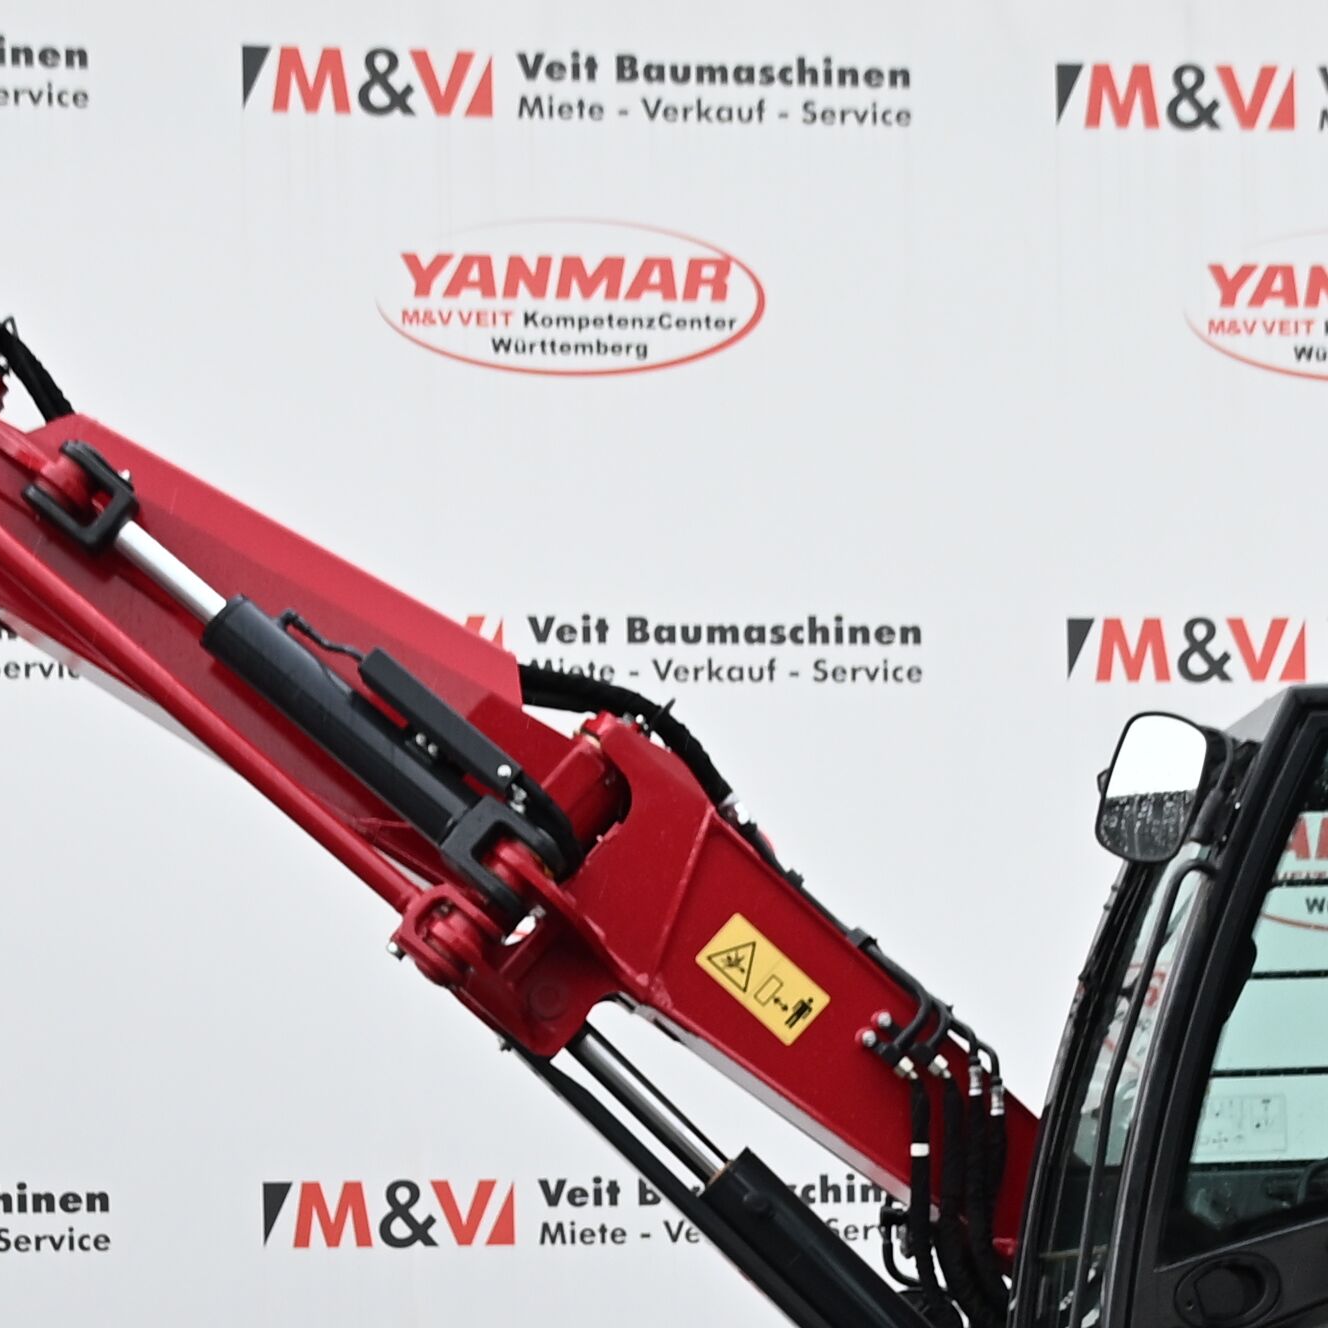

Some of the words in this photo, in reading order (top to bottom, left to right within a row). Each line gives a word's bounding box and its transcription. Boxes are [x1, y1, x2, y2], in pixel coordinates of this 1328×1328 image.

[273, 46, 474, 117] M&V
[517, 50, 598, 82] Veit
[616, 54, 910, 88] Baumaschinen
[518, 95, 604, 120] Miete
[641, 97, 765, 123] Verkauf
[803, 100, 911, 126] Service
[1085, 63, 1277, 131] M&V
[401, 253, 732, 302] YANMAR
[402, 309, 456, 328] M&V
[459, 310, 513, 328] VEIT
[523, 312, 737, 335] KompetenzCenter
[1208, 320, 1257, 336] M&V
[1261, 320, 1314, 336] VEIT
[492, 336, 649, 360] Württemberg
[528, 614, 609, 644] Veit
[627, 615, 921, 645] Baumaschinen
[1097, 618, 1281, 682] M&V
[652, 658, 776, 682] Verkauf
[814, 659, 922, 683] Service
[538, 1176, 620, 1207] Veit
[294, 1180, 494, 1249] M&V
[540, 1221, 627, 1245] Miete
